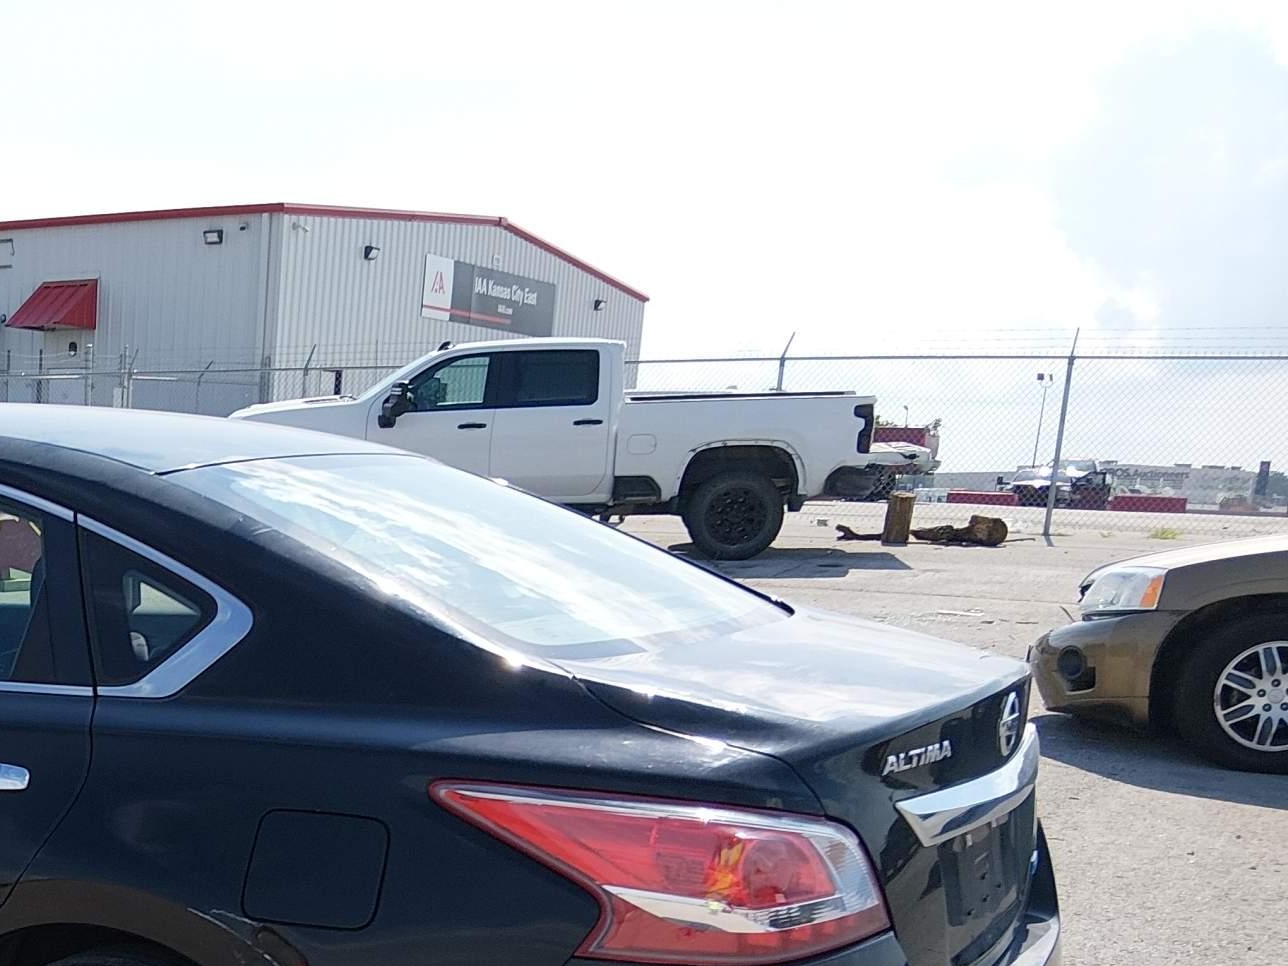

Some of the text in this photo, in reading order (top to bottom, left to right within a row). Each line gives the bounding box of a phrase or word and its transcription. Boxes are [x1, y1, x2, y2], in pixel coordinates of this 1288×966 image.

[475, 276, 537, 307] IAA Kansas City East
[881, 740, 952, 776] ALTIMA
